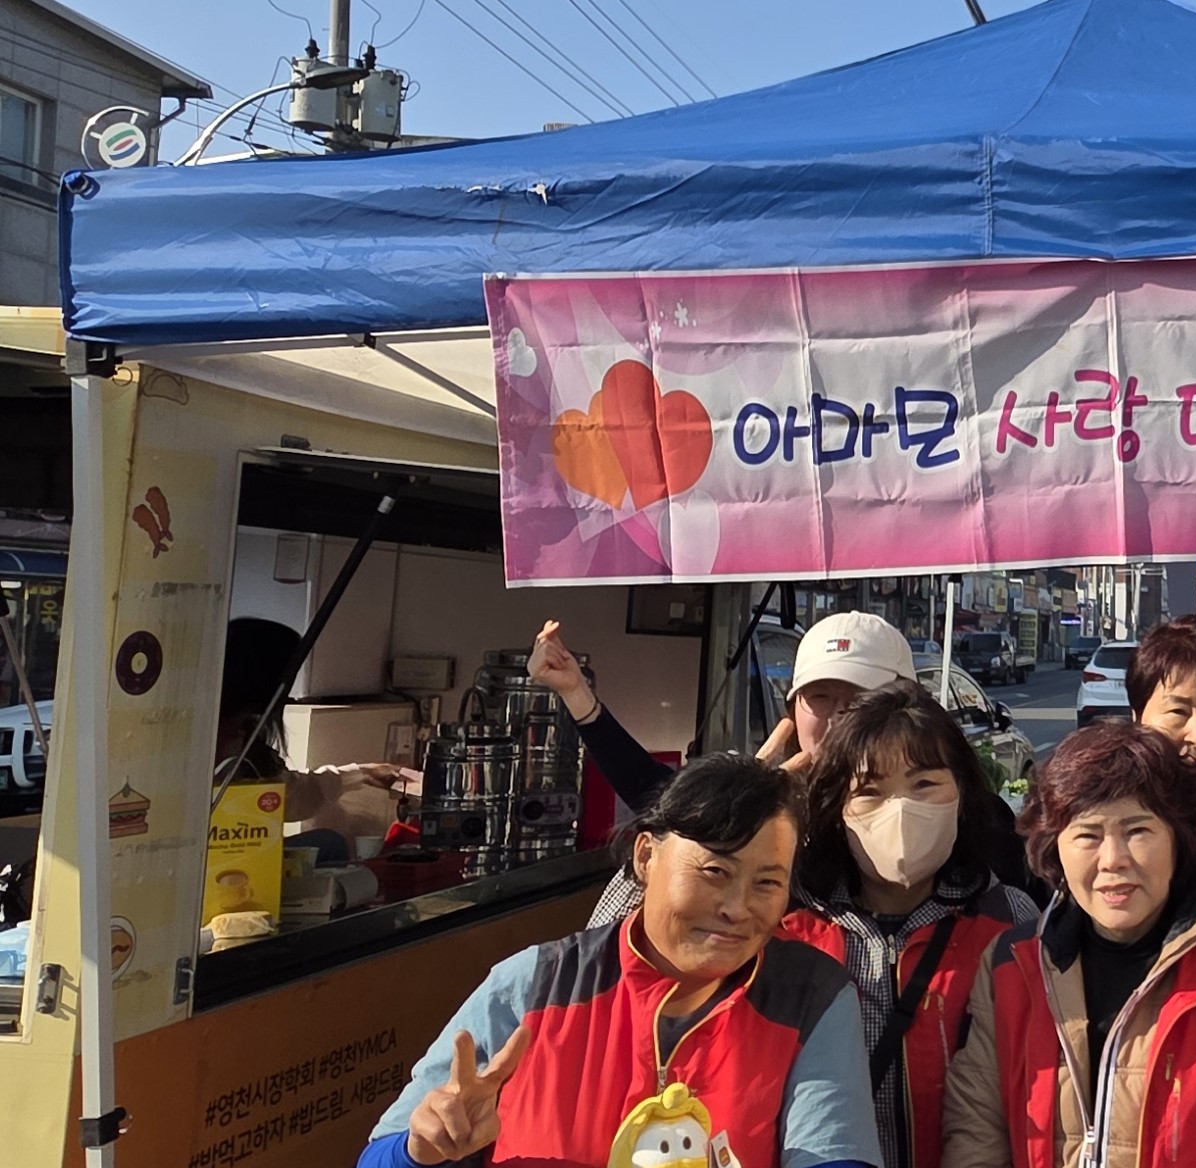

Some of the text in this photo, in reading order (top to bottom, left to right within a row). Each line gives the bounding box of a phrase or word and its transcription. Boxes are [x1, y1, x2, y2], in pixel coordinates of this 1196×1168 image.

[733, 387, 960, 468] 아마모
[996, 369, 1148, 462] 사랑
[205, 1027, 397, 1129] #영천시장학회 #영천YMCA
